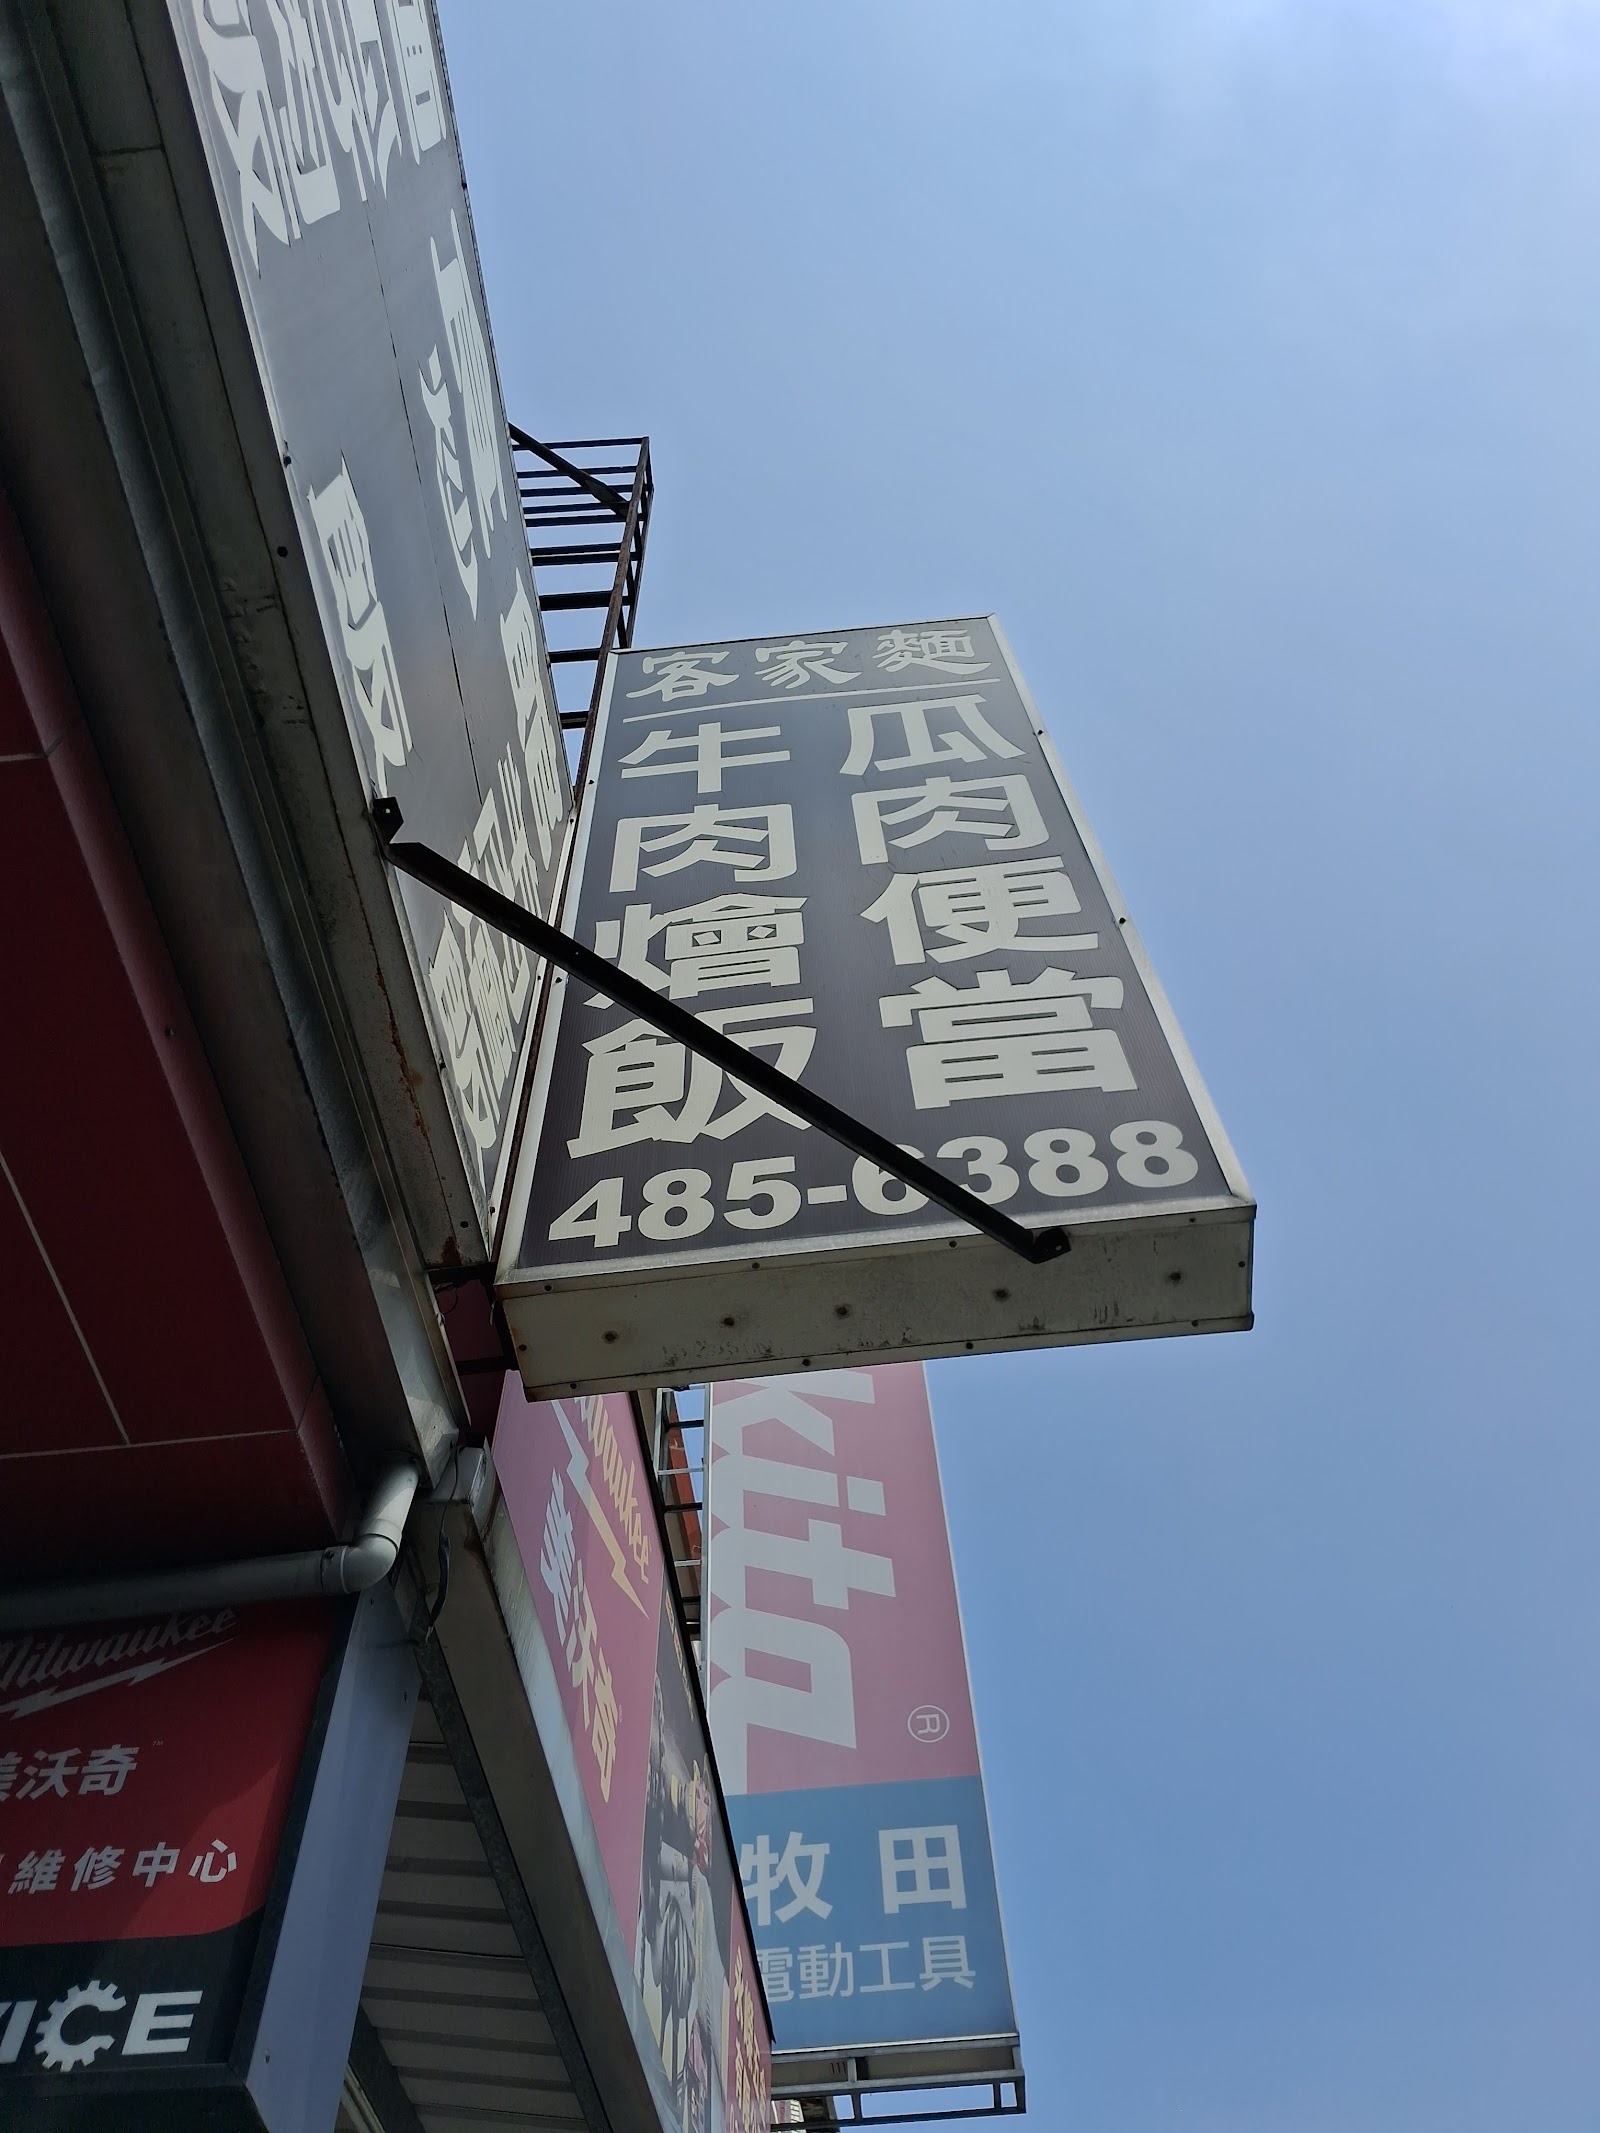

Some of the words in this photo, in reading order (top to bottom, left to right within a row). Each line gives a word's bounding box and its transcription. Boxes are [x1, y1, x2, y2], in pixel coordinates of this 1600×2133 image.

[626, 627, 993, 703] 客家麵
[567, 722, 818, 1160] 牛肉燴飯
[840, 694, 1139, 1111] 瓜肉便當
[547, 1120, 1199, 1248] 485-6388
[0, 1838, 238, 1894] 維修中心
[739, 1824, 968, 1927] 牧田
[757, 1935, 977, 2004] 電動工具
[0, 1980, 204, 2072] ICE
